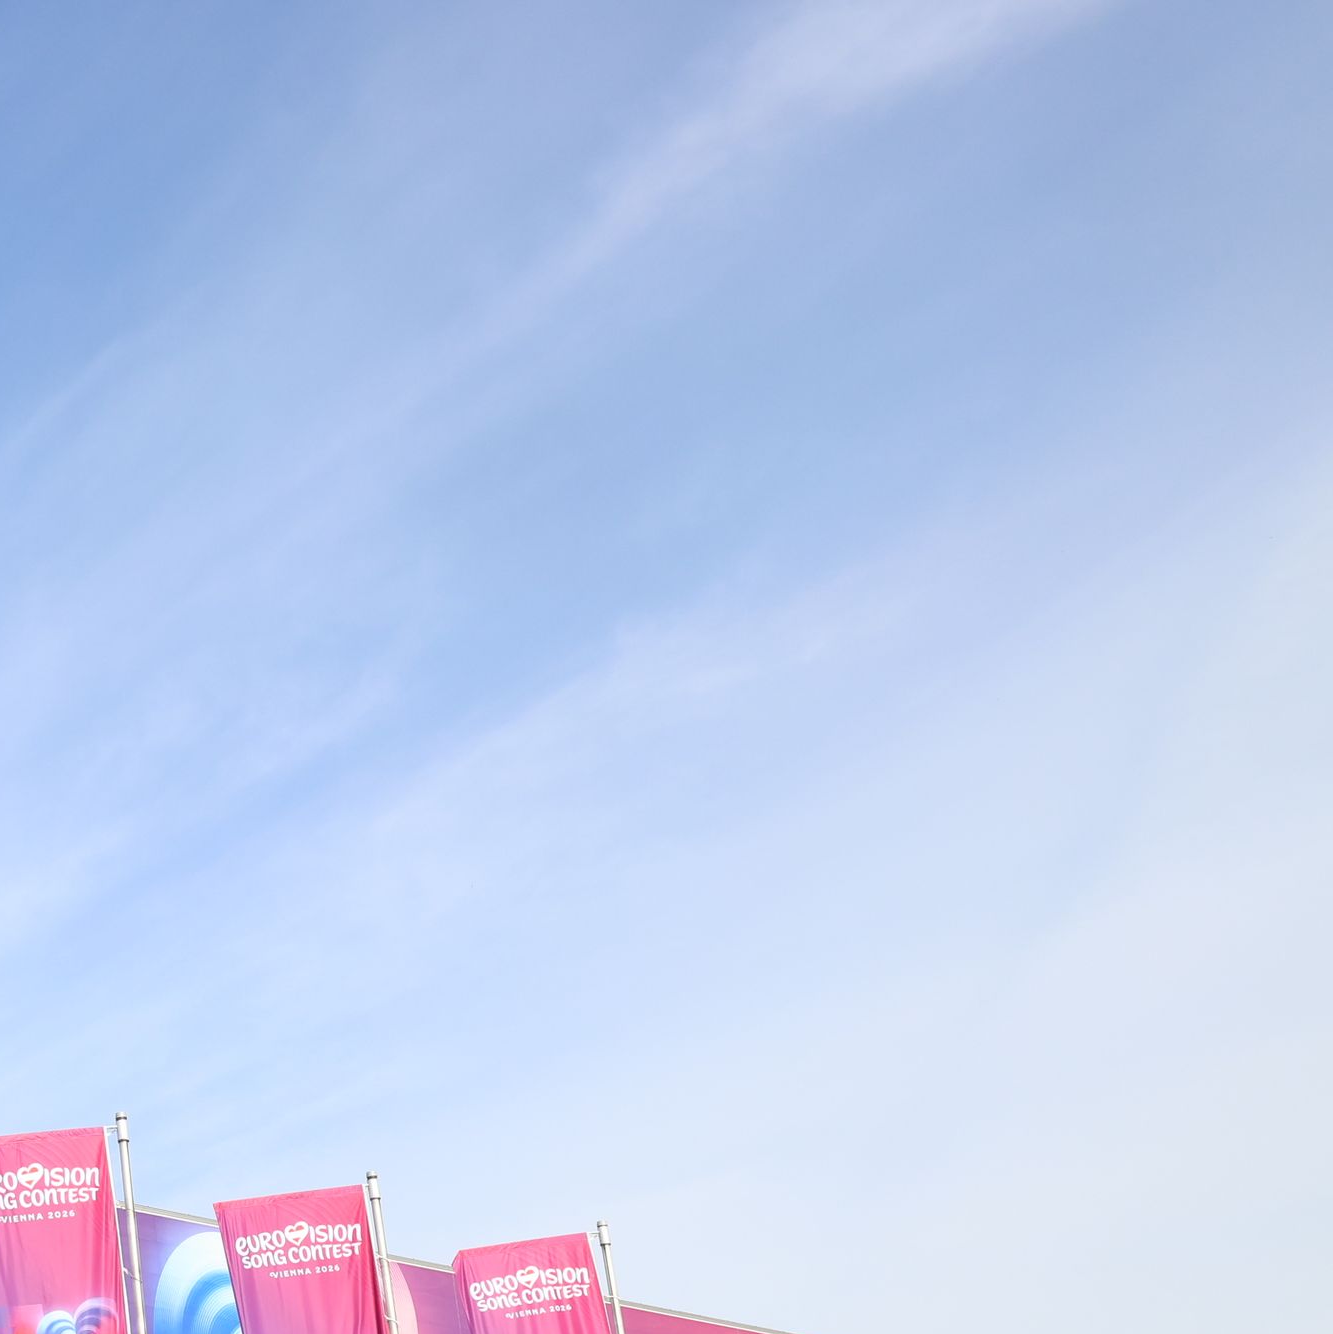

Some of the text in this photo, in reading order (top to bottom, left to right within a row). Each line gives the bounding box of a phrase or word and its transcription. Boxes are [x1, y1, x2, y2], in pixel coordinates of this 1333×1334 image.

[19, 1187, 99, 1208] CONTEST
[48, 1209, 75, 1219] 2026
[242, 1242, 362, 1269] SONG CONTEST
[269, 1264, 340, 1279] VIENNA 2026
[477, 1284, 590, 1312] SONG CONTEST
[505, 1308, 546, 1319] VIENNA
